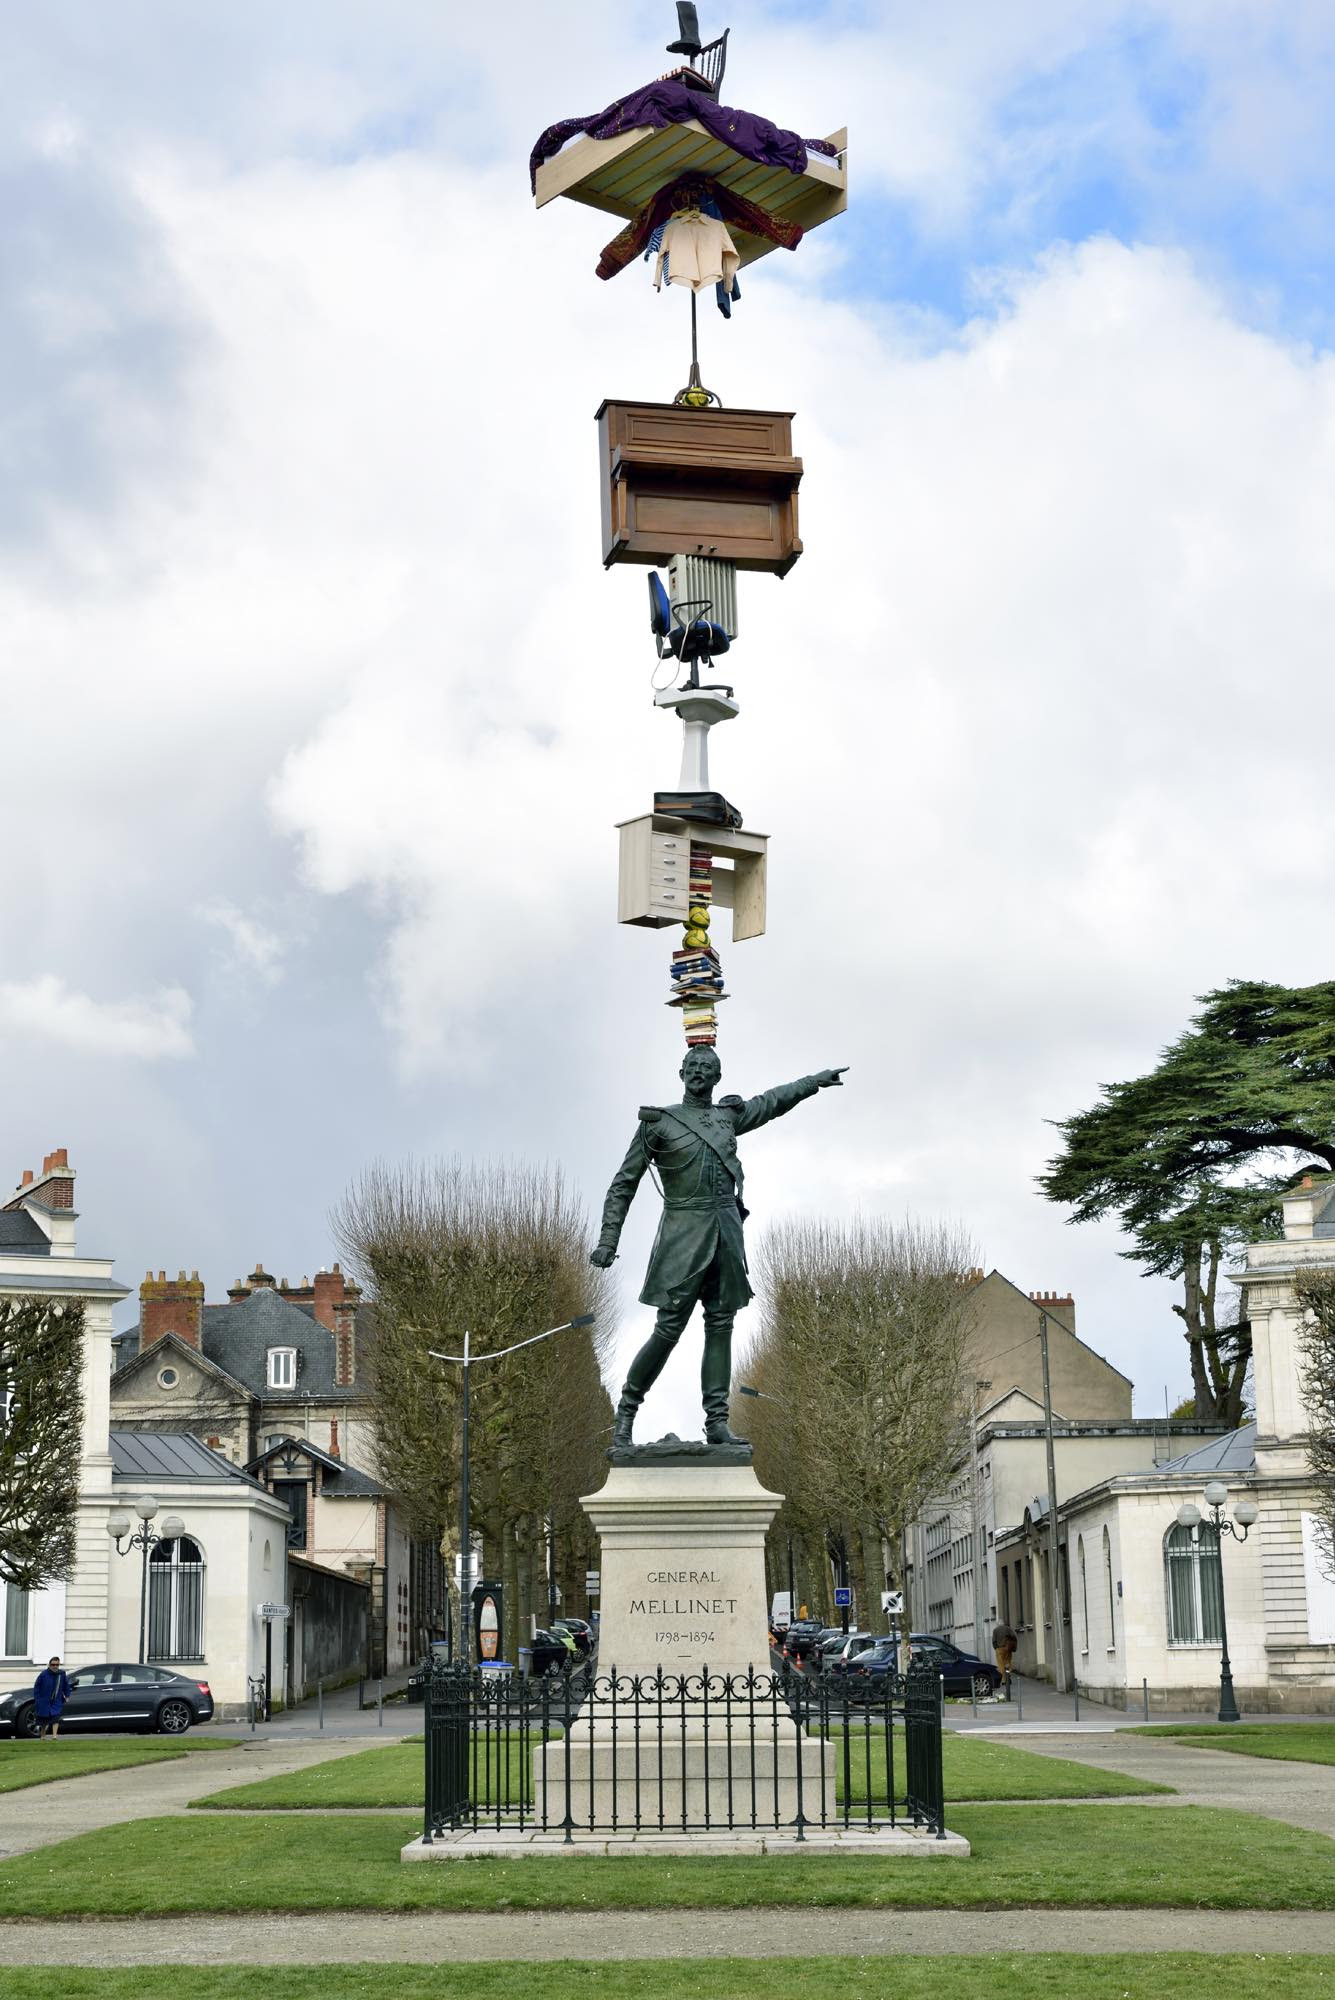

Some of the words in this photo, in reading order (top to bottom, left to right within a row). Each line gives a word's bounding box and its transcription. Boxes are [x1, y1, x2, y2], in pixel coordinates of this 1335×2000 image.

[647, 1571, 720, 1585] GENERAL
[629, 1599, 738, 1614] MELLINET
[655, 1631, 715, 1645] 1798-1894
